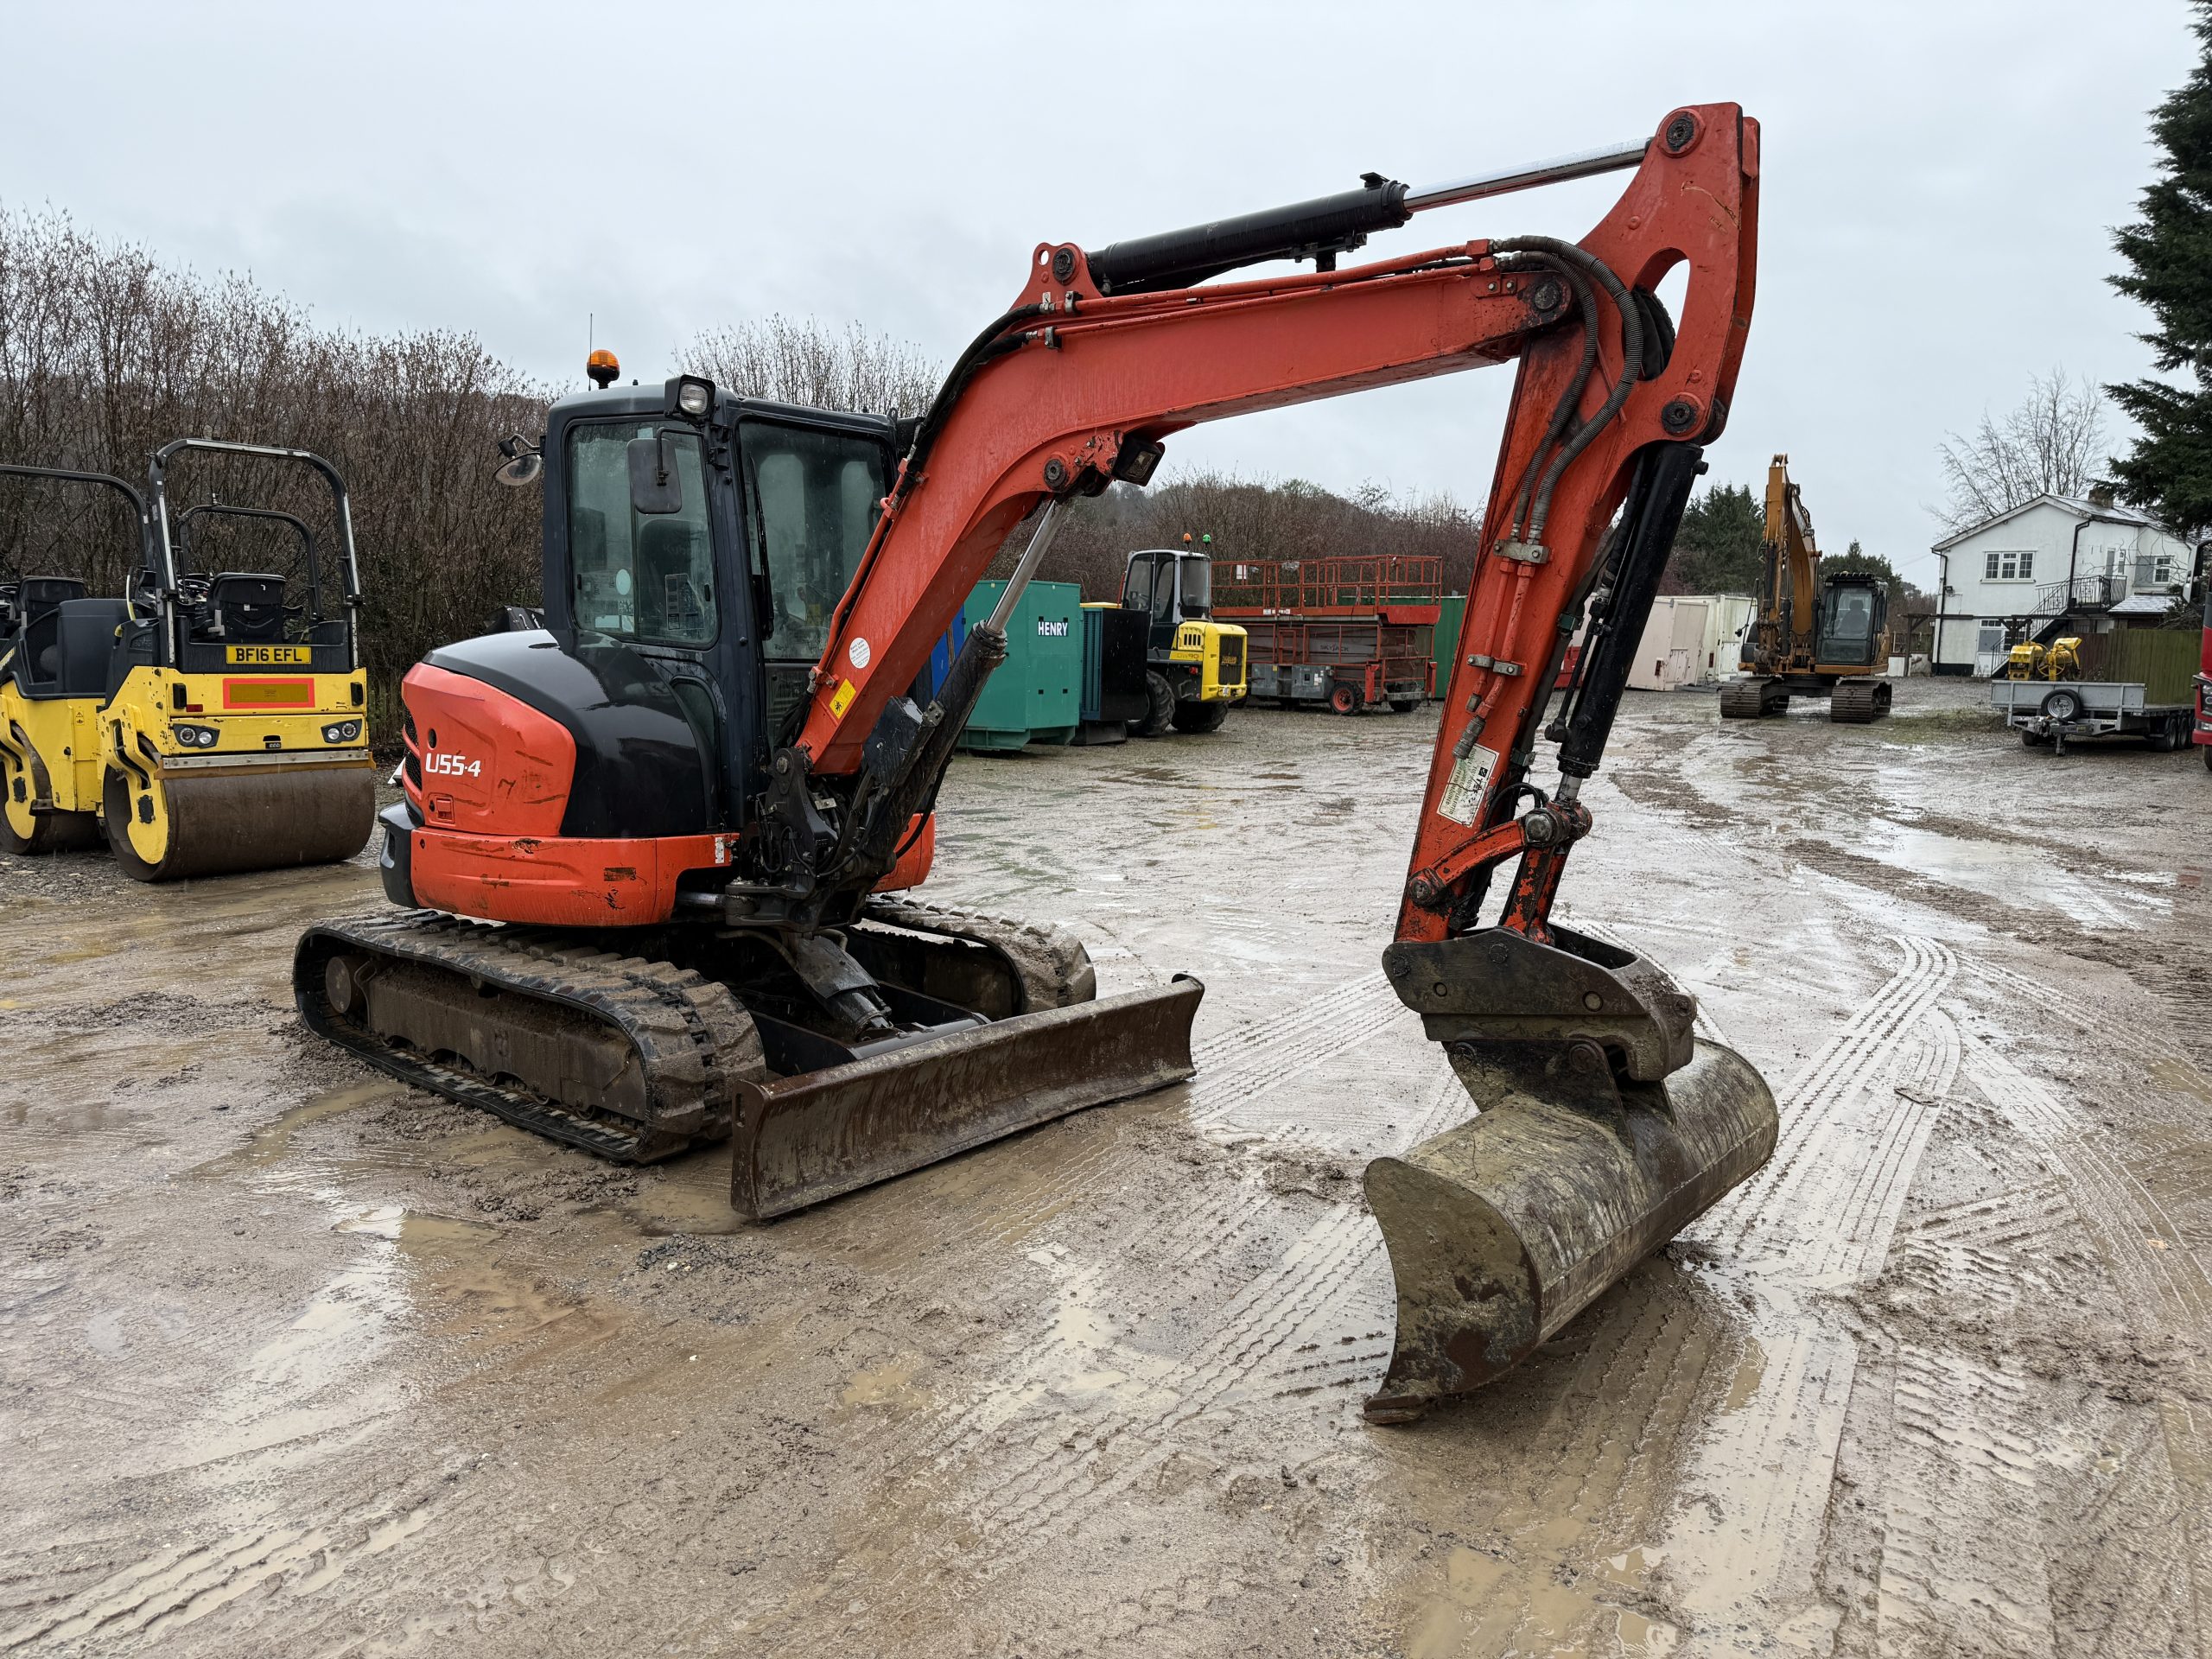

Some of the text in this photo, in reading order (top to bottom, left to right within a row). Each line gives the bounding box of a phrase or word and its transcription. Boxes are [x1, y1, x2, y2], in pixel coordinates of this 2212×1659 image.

[1038, 621, 1068, 637] HENRY
[236, 648, 302, 662] BF16 EFL
[425, 753, 481, 777] U55-4
